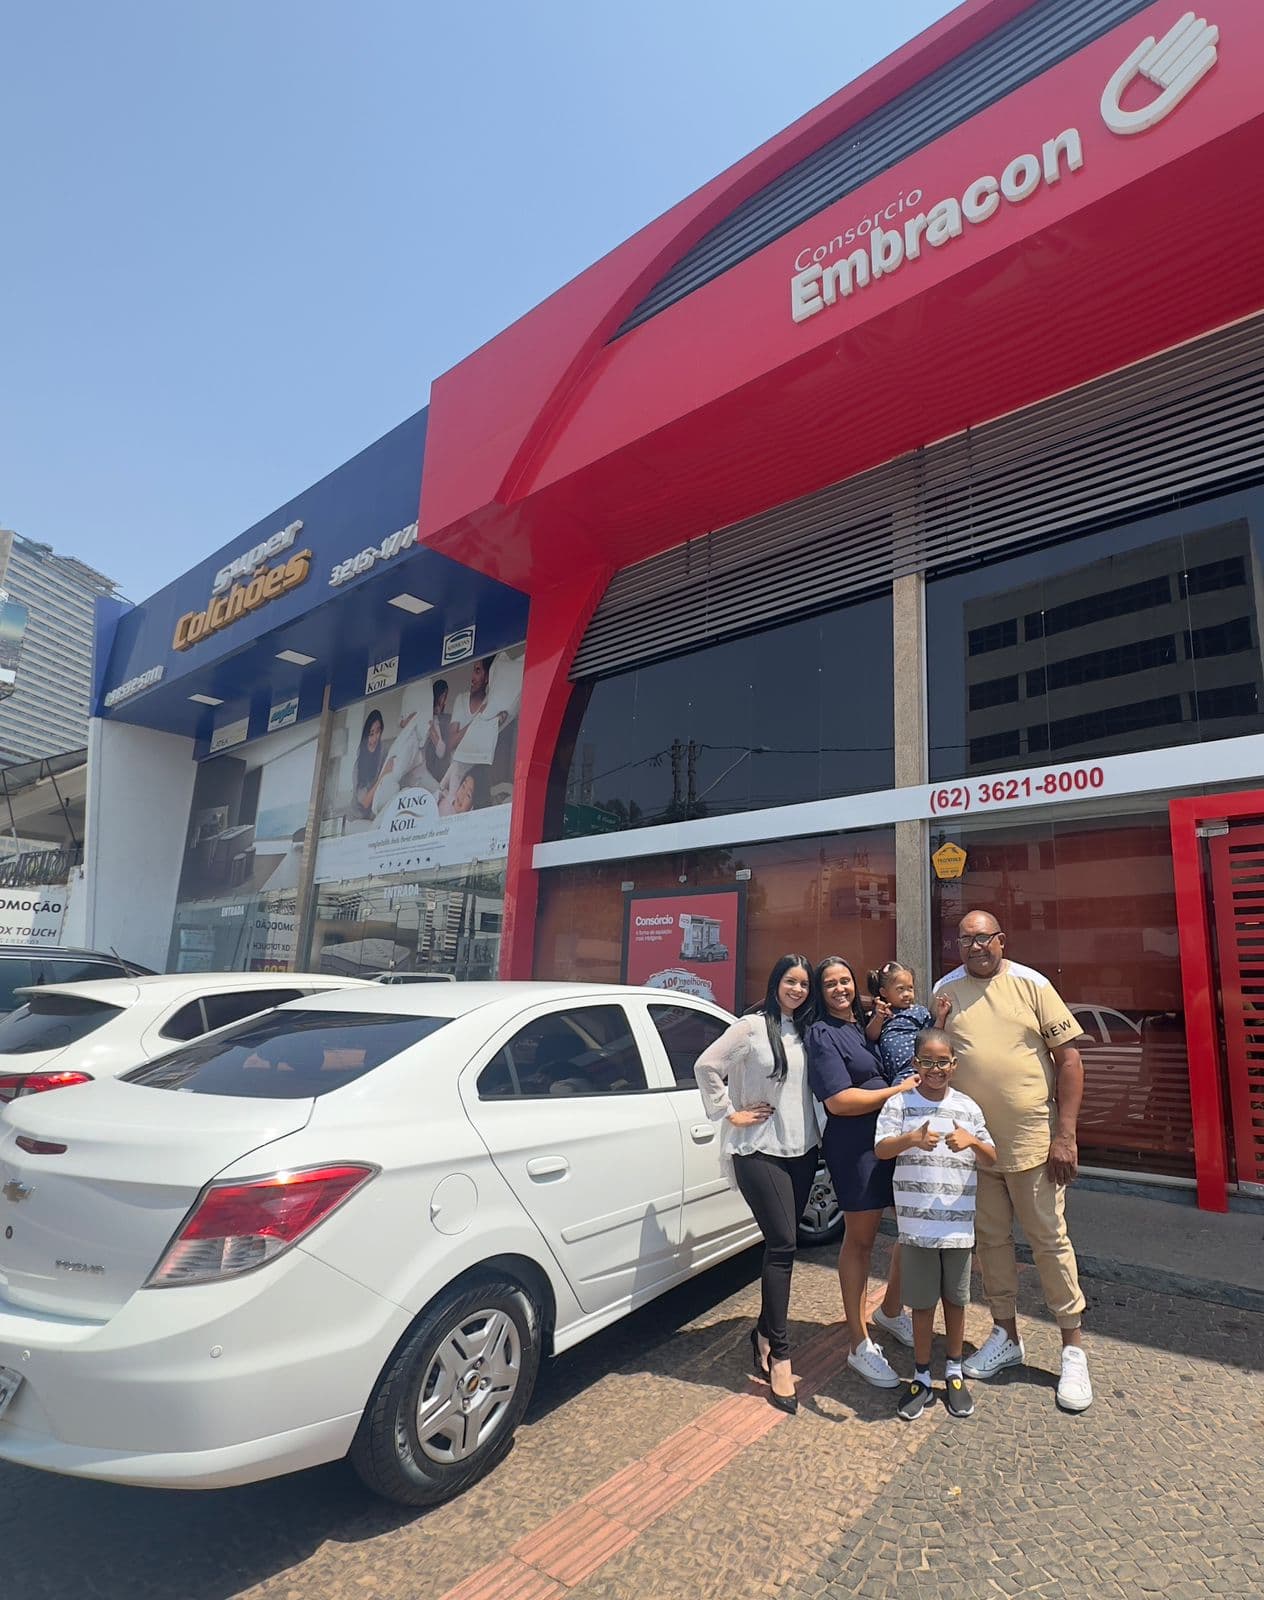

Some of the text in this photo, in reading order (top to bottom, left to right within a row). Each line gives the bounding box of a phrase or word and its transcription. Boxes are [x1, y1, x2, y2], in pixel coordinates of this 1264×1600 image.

[791, 127, 1084, 323] Embracon
[794, 189, 923, 272] Consórcio
[212, 519, 304, 595] super
[328, 519, 418, 587] 3215-177
[172, 548, 312, 651] Colchões
[373, 658, 396, 675] KING
[366, 678, 387, 693] KOIL
[930, 767, 1104, 814] (62) 3621-8000
[397, 794, 428, 811] KING
[389, 818, 416, 832] KOIL
[383, 884, 420, 900] ENTRADA
[221, 905, 245, 918] ENTRADA
[635, 914, 674, 926] Consórcio
[16, 927, 57, 938] TOUCH
[1041, 1019, 1072, 1040] NEW
